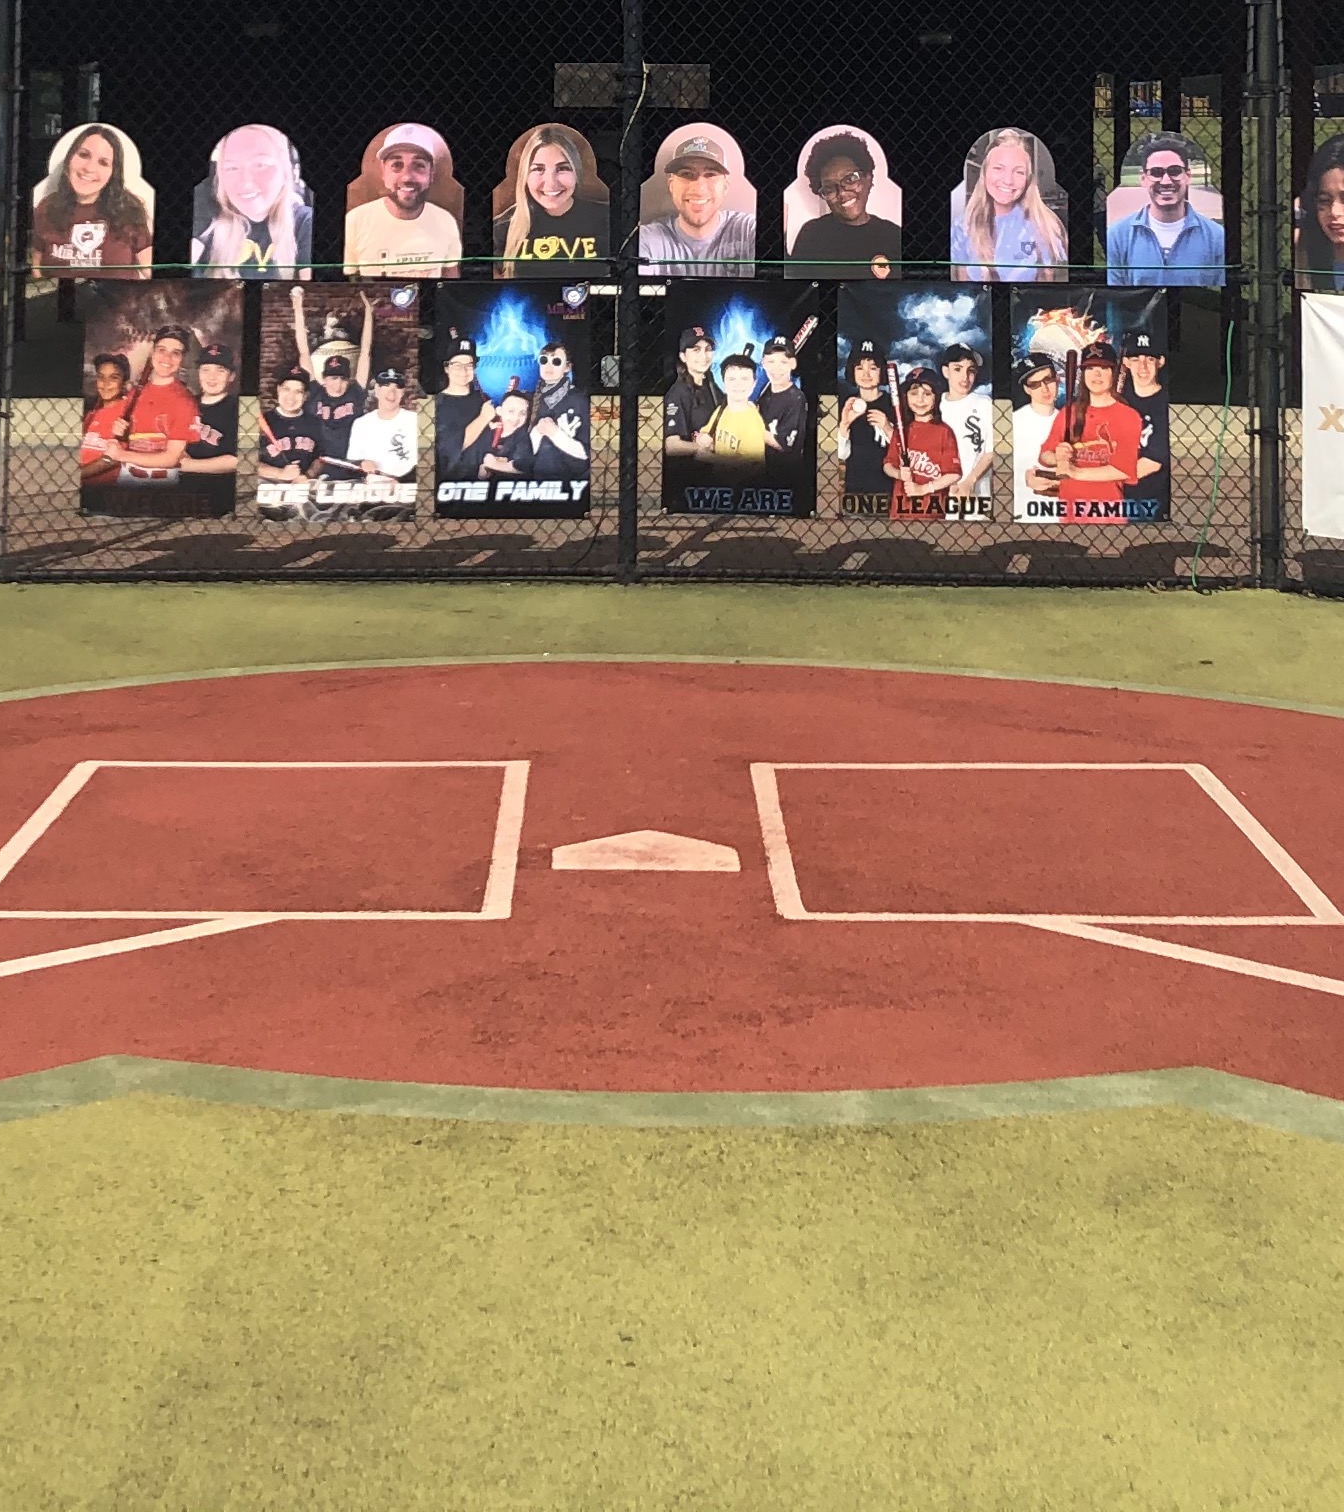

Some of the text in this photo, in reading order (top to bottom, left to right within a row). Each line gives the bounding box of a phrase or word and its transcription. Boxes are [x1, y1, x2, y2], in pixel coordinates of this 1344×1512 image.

[257, 482, 418, 504] ONE LEAGUE
[437, 479, 589, 502] ONE FAMILY
[684, 486, 793, 513] WE ARE
[842, 494, 992, 515] ONE LEAGUE
[1026, 498, 1159, 519] ONE FAMILY
